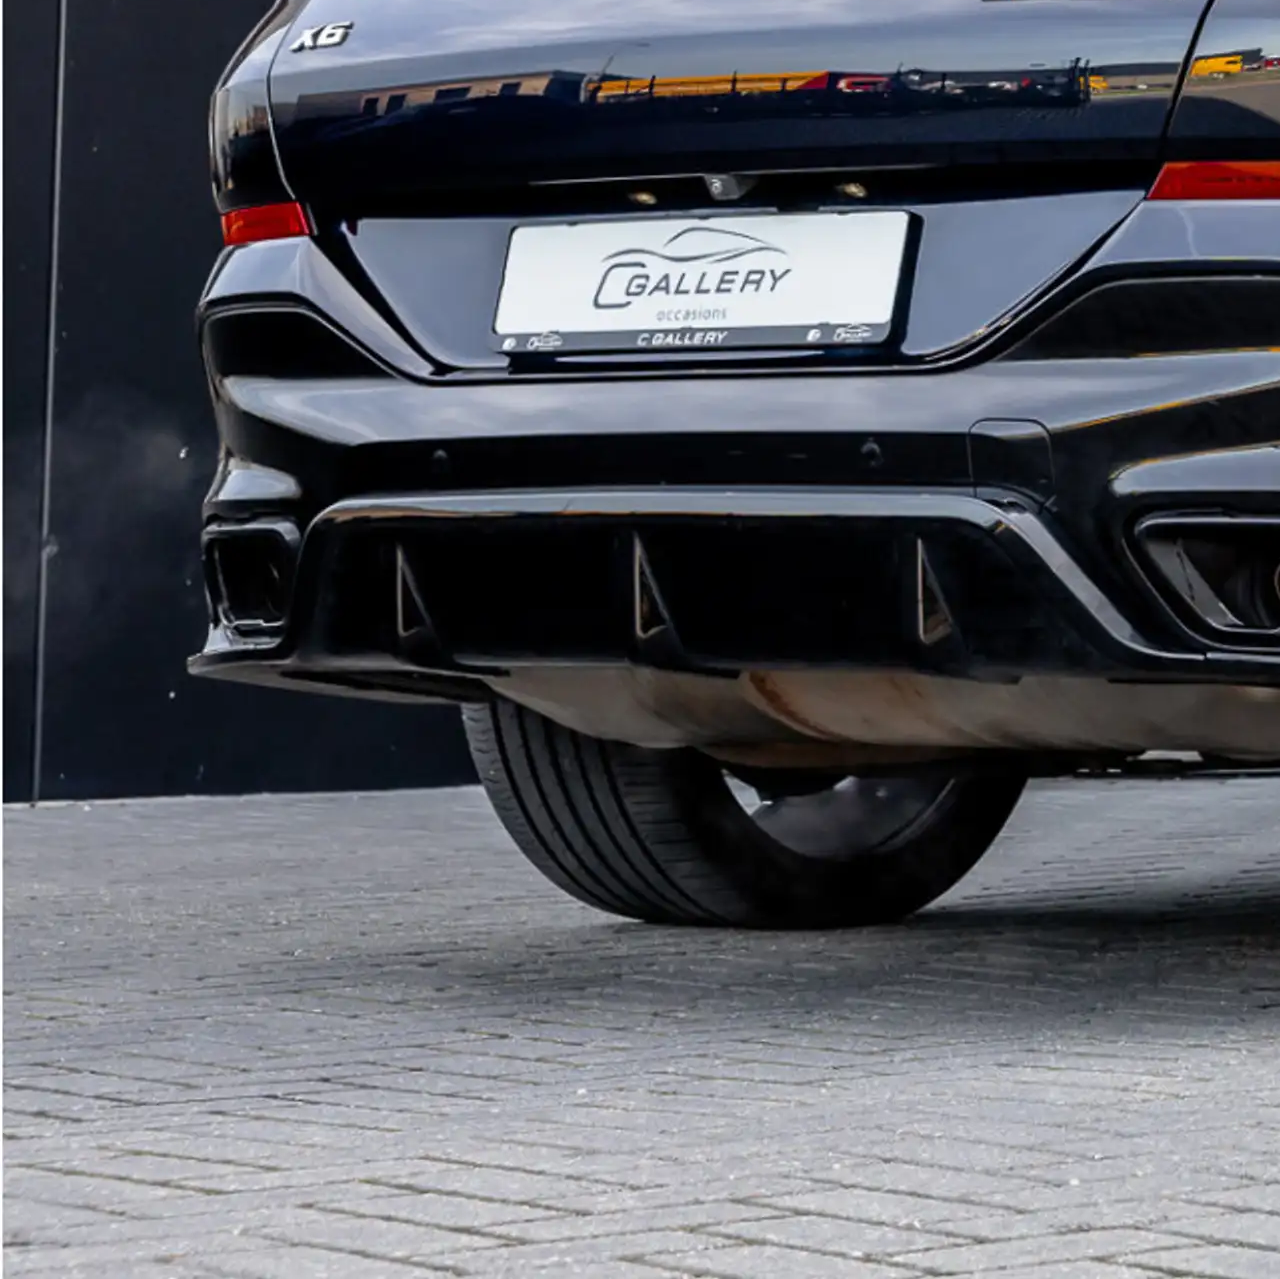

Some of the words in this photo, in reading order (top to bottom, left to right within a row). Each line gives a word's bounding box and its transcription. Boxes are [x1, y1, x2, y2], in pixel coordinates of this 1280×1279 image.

[289, 21, 355, 54] X6
[624, 268, 792, 298] GALLERY
[656, 307, 728, 324] occasions
[636, 332, 650, 347] C
[650, 330, 729, 347] GALLERY
